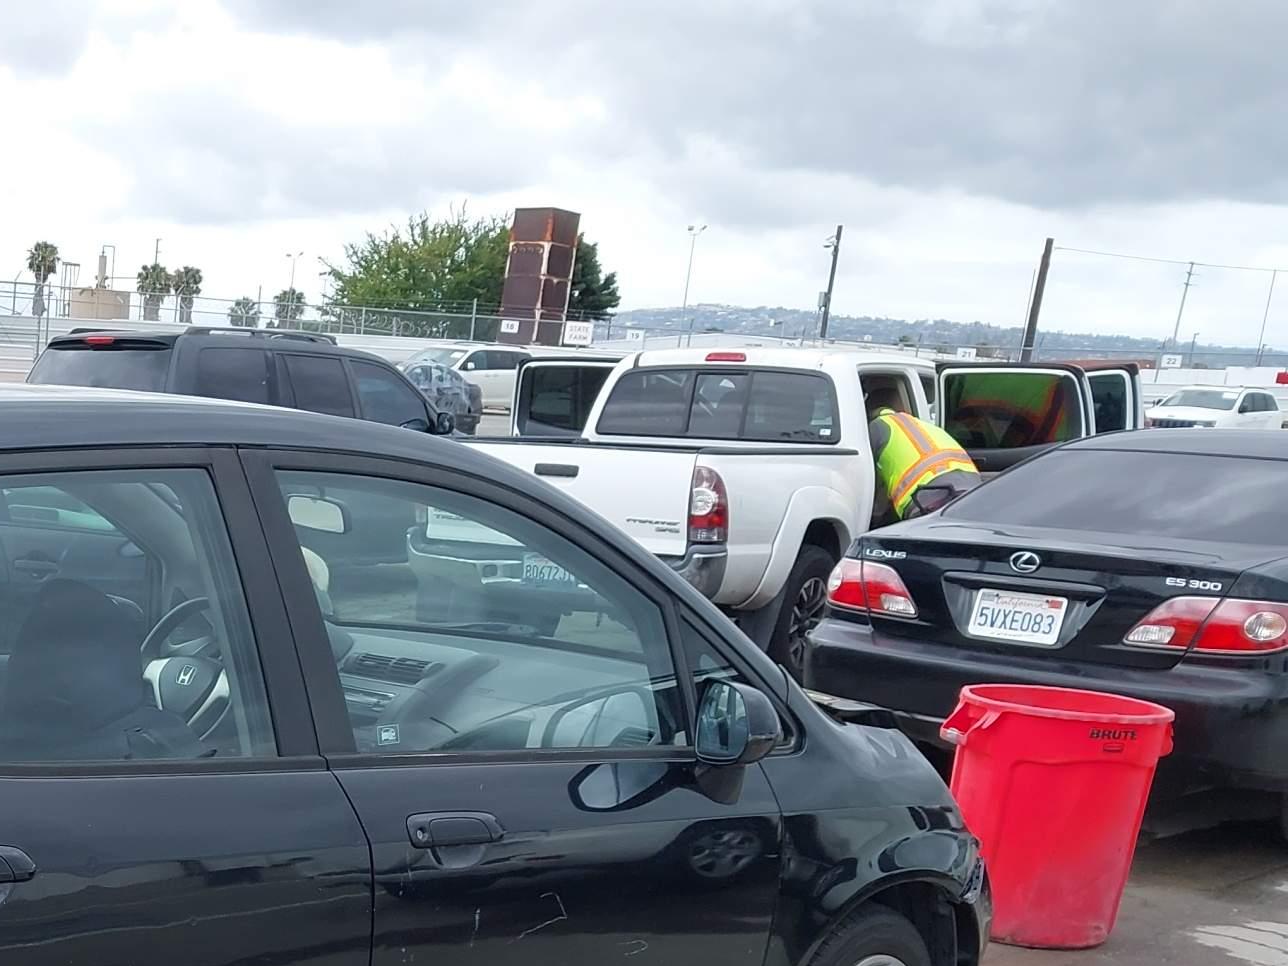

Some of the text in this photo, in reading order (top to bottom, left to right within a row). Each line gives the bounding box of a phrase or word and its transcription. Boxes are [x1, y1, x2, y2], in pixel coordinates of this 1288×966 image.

[1166, 357, 1177, 365] 22
[865, 548, 907, 559] LEXUS
[1165, 577, 1222, 591] ES 300
[977, 606, 1055, 635] 5VXE083
[1090, 728, 1137, 741] BRUTE
